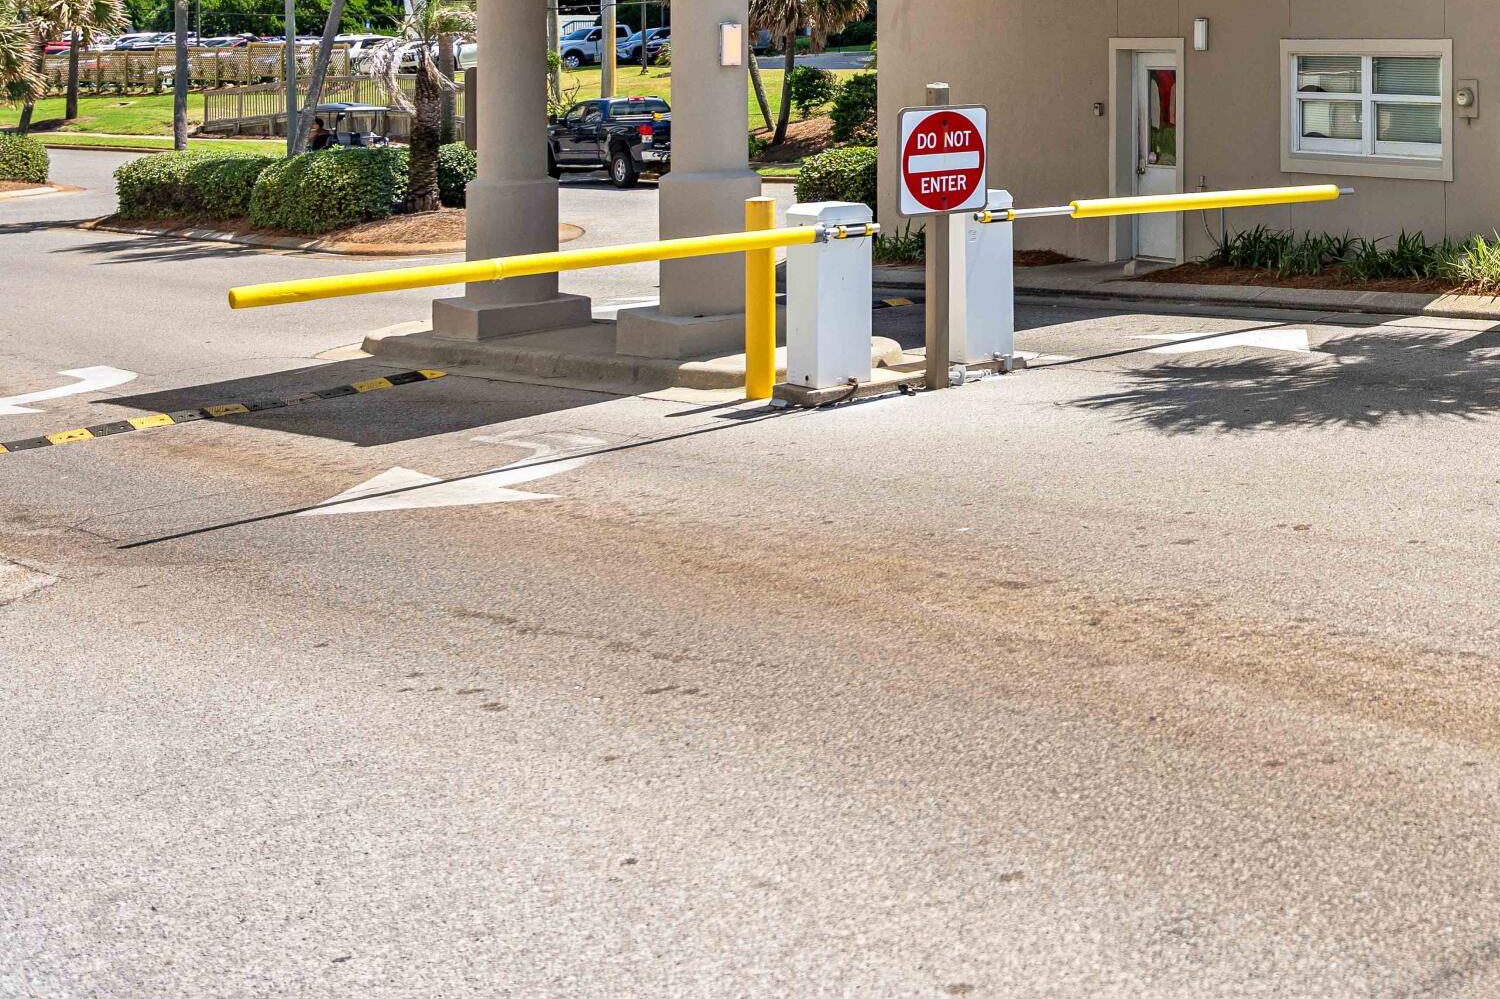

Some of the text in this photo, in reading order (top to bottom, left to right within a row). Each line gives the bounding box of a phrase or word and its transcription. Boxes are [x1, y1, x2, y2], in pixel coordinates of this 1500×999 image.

[917, 130, 971, 150] DO NOT
[921, 174, 967, 194] ENTER
